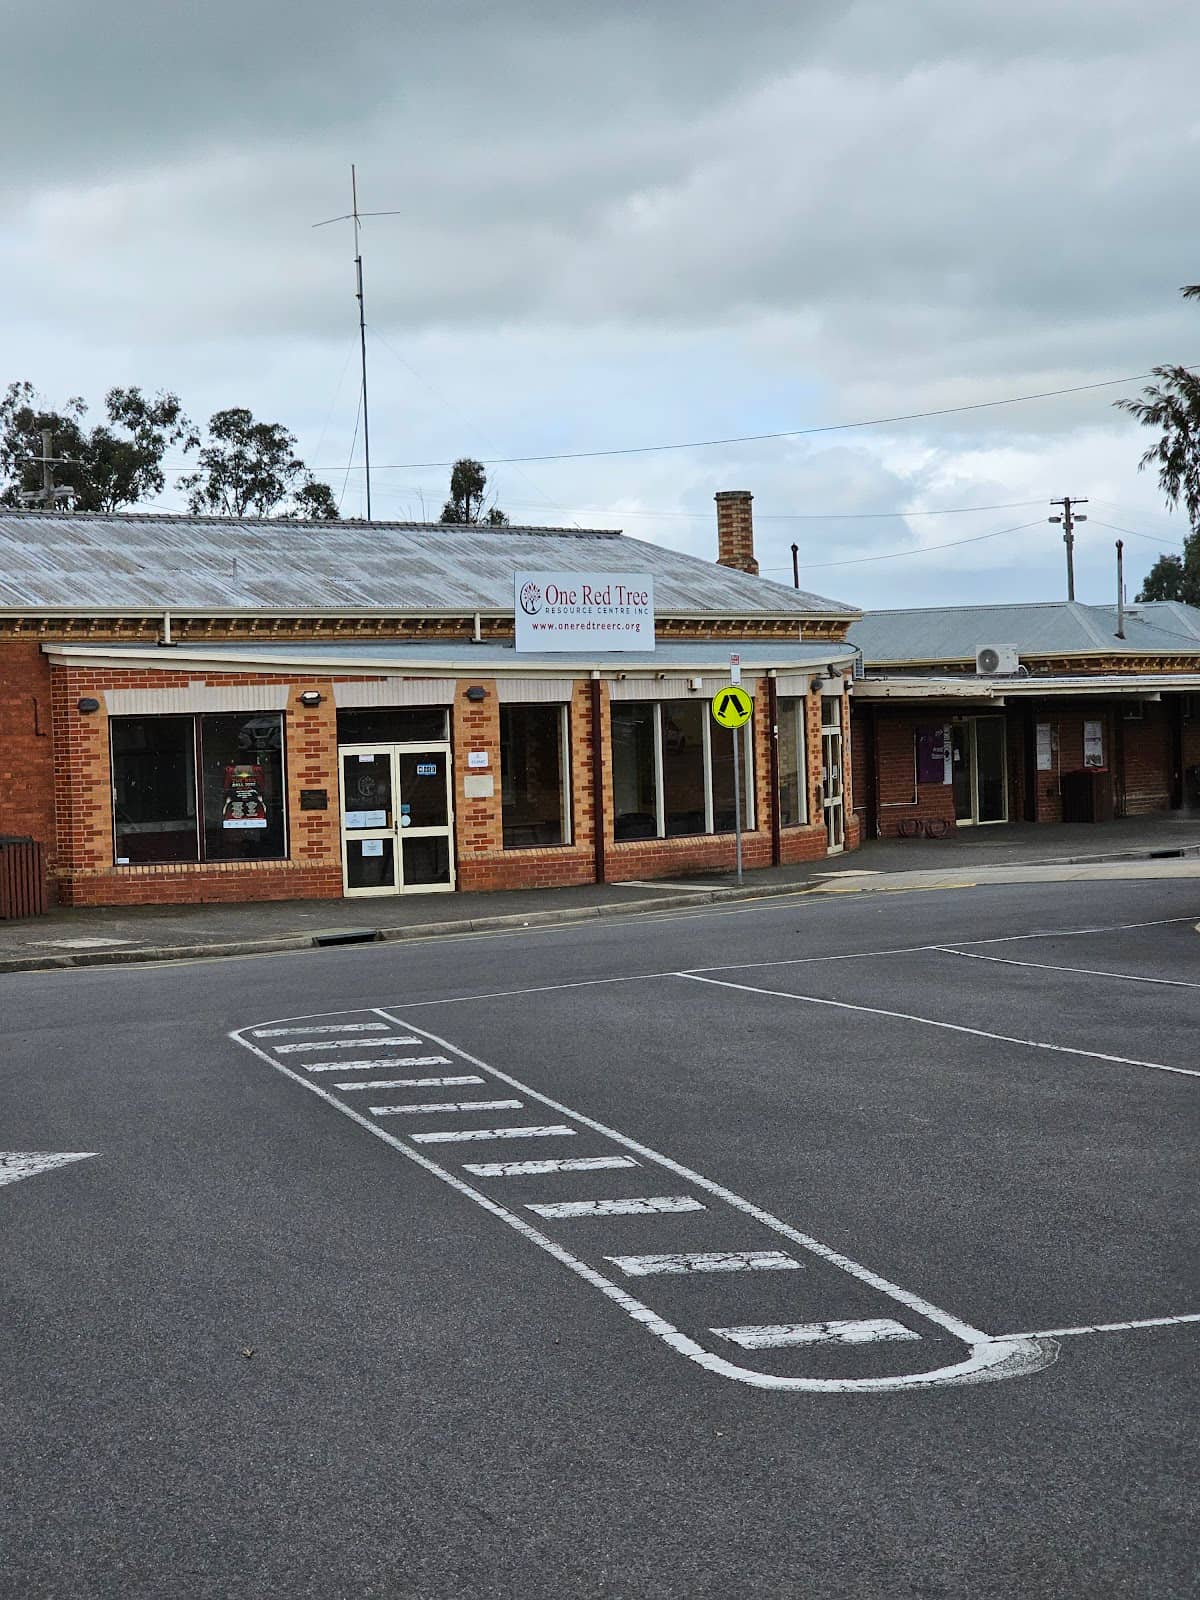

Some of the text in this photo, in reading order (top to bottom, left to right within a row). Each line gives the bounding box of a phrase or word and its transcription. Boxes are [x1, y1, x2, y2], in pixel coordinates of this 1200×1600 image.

[545, 584, 648, 606] One Red Tree
[597, 607, 630, 615] CENTRE
[532, 621, 641, 632] www.oneredtreerc.org
